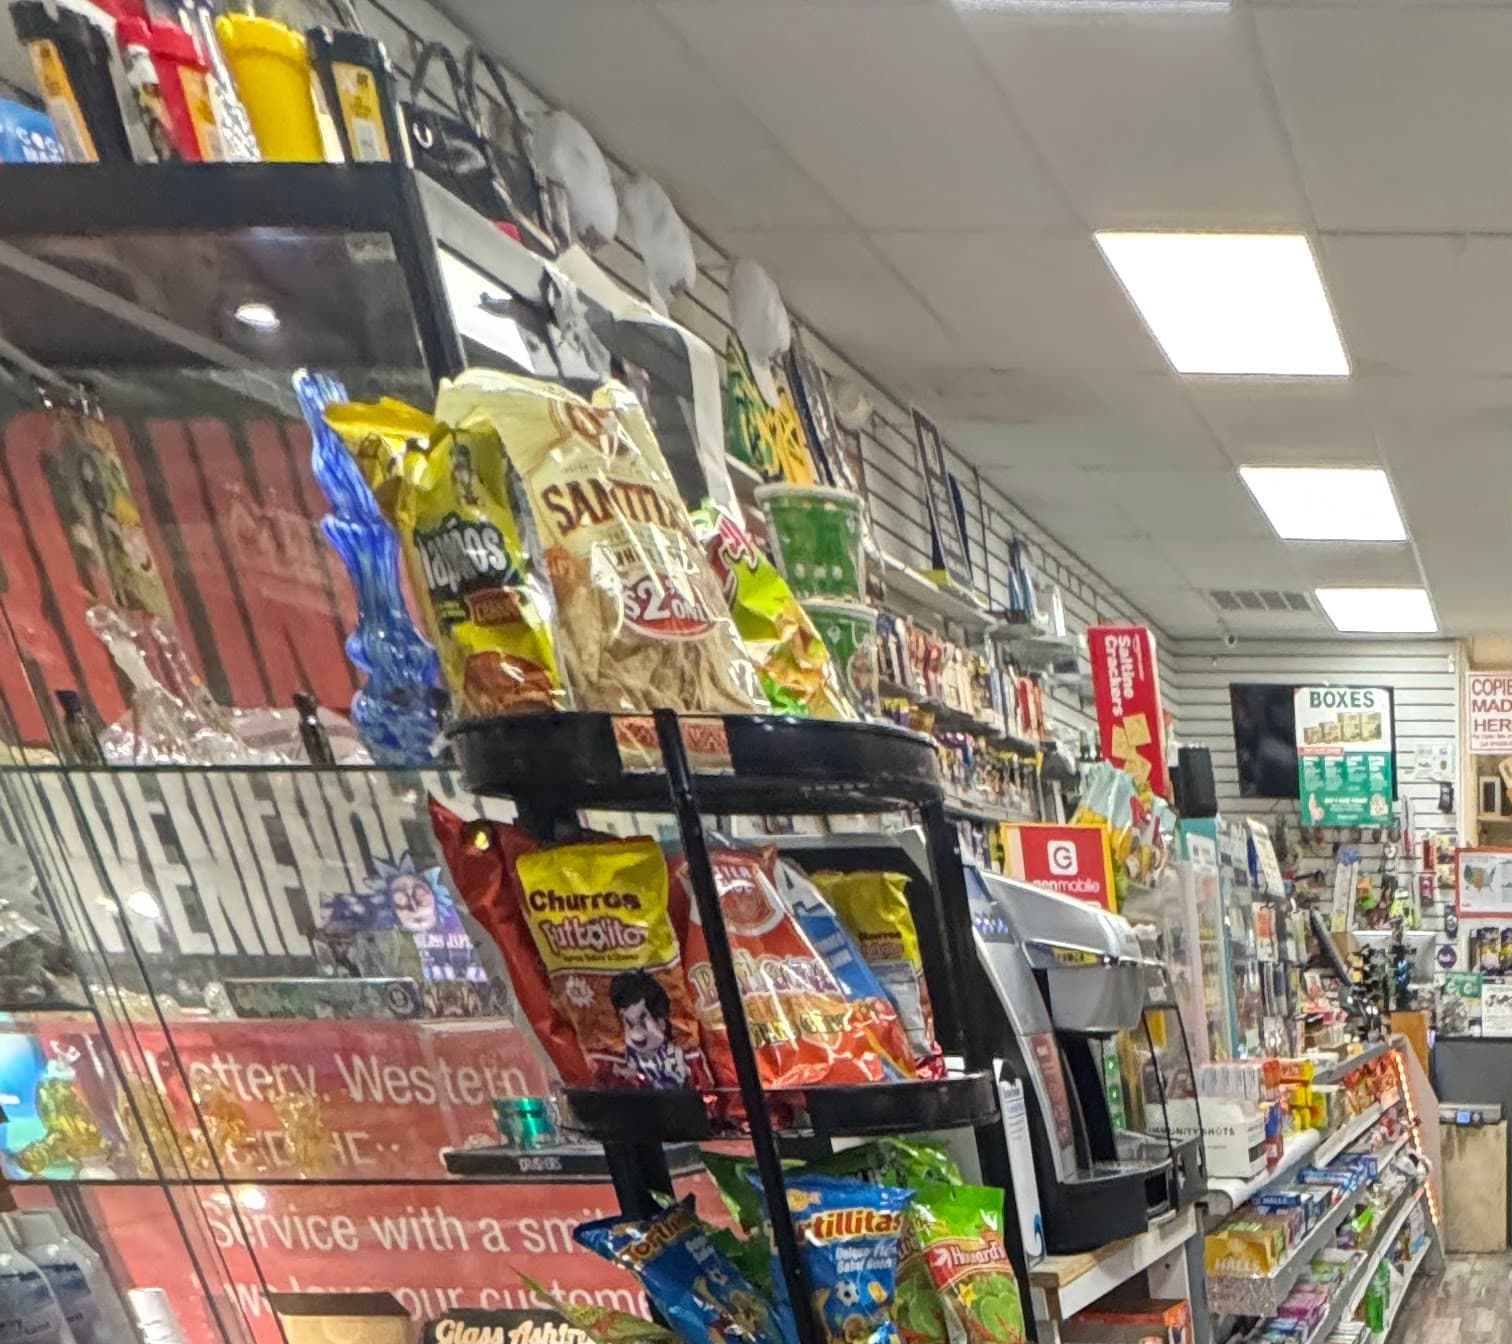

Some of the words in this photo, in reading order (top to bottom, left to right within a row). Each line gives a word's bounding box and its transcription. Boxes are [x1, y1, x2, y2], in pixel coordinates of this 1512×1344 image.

[1104, 635, 1124, 718] Crackers
[1118, 635, 1135, 700] Saltine
[1309, 691, 1375, 708] BOXES
[529, 890, 642, 912] Churros
[334, 1053, 526, 1105] Western
[203, 1198, 358, 1252] Service
[368, 1204, 470, 1252] with
[480, 1218, 512, 1253] a
